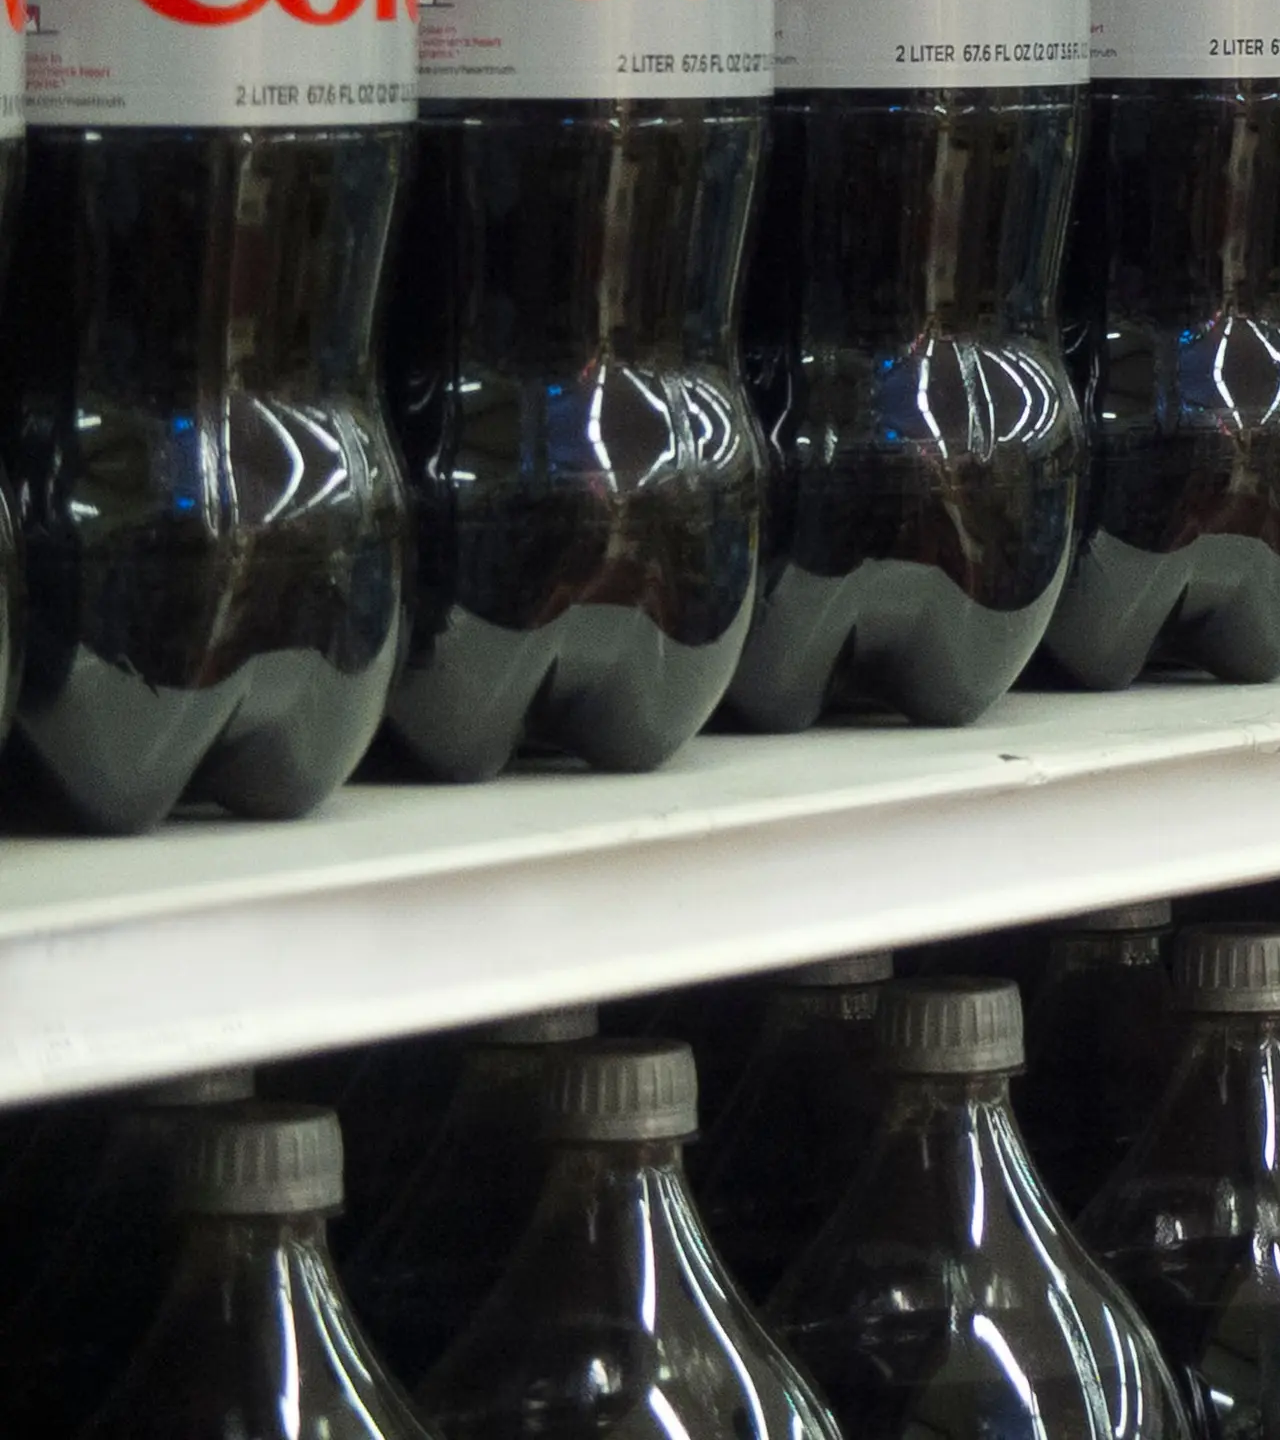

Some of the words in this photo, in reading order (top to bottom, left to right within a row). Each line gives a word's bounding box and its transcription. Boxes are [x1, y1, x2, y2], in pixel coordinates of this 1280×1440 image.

[895, 45, 905, 63] 2
[911, 45, 955, 62] LITER
[963, 44, 991, 62] 67.6
[995, 44, 1010, 62] FL
[1014, 44, 1031, 61] OZ
[1209, 39, 1218, 56] 2
[1223, 39, 1264, 56] LITER
[617, 54, 627, 73] 2
[632, 54, 674, 73] LITER
[682, 54, 707, 73] 67.6
[711, 54, 724, 73] FL
[726, 54, 740, 73] OZ
[236, 86, 246, 106] 2
[252, 85, 299, 106] LITER
[307, 84, 336, 105] 67.6
[339, 84, 355, 105] FL
[358, 84, 374, 105] OZ
